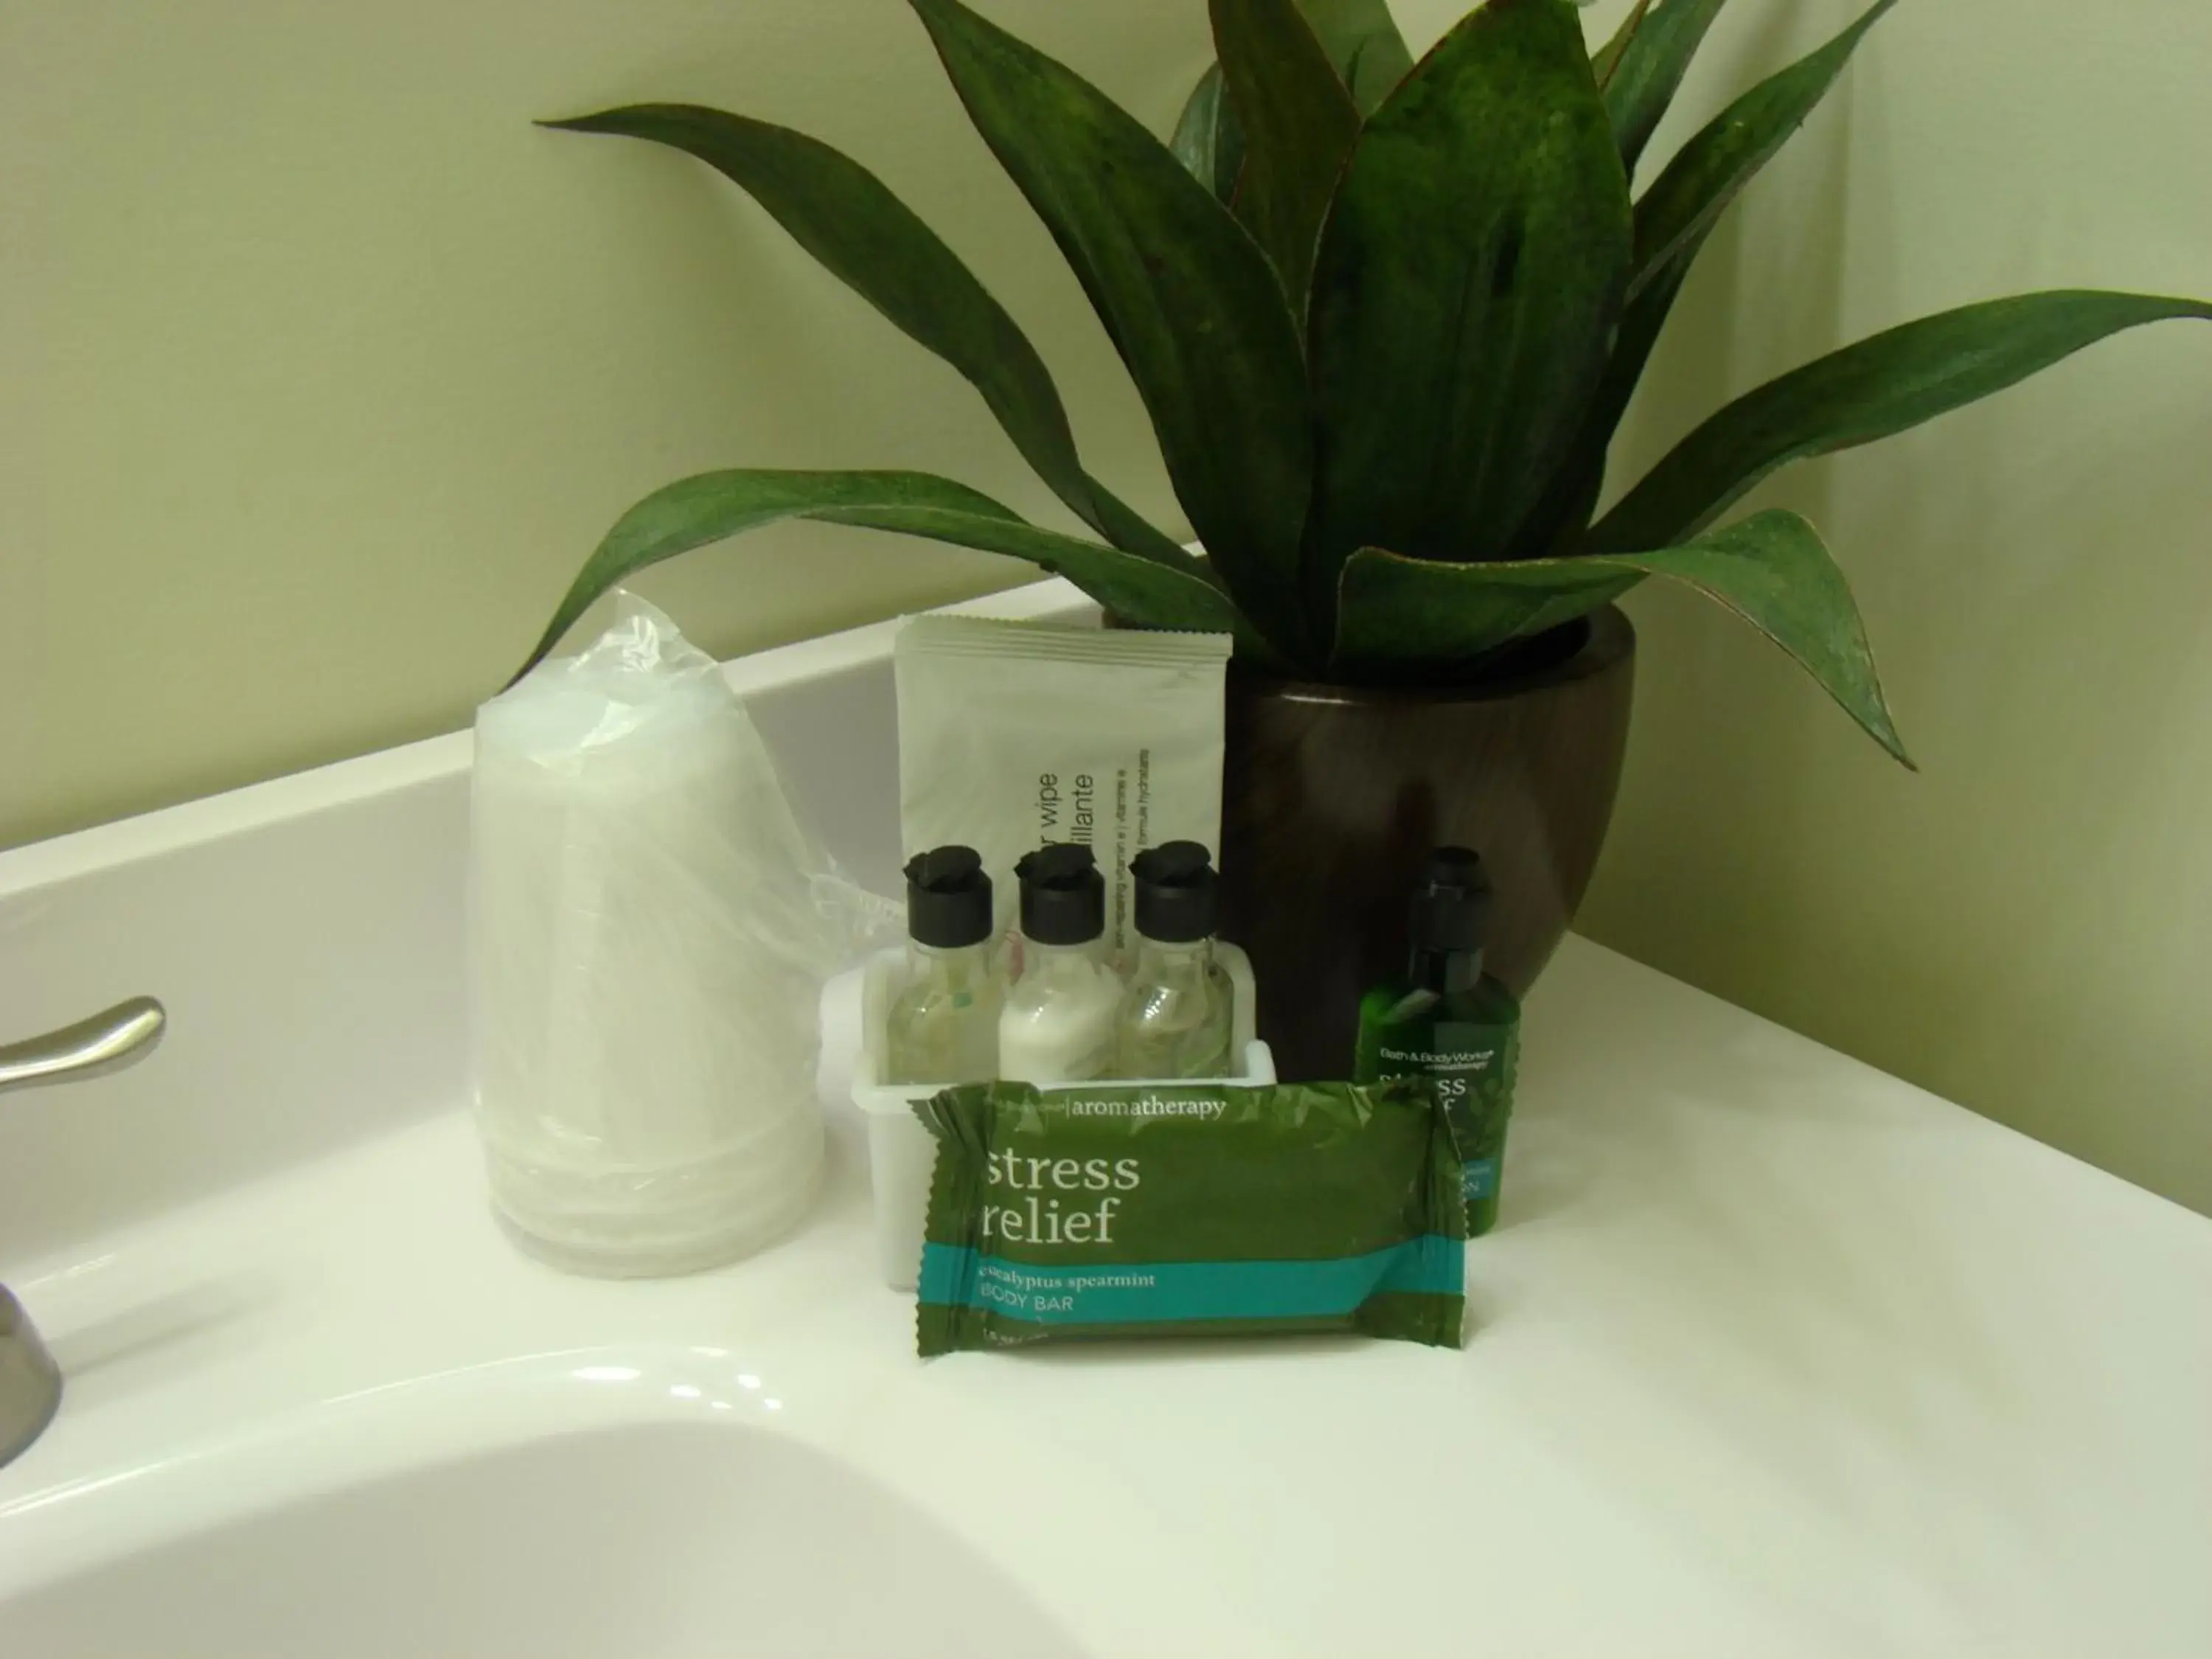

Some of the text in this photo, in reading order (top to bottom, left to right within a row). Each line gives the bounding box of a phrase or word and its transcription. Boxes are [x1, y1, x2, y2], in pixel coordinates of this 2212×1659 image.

[1035, 773, 1062, 829] wipe
[1071, 774, 1094, 844] illante
[1071, 1095, 1228, 1121] aromatherapy
[988, 1147, 1141, 1192] stress
[981, 1197, 1121, 1244] relief
[981, 1282, 1074, 1311] BODY BAR
[1068, 1275, 1156, 1293] spearmint
